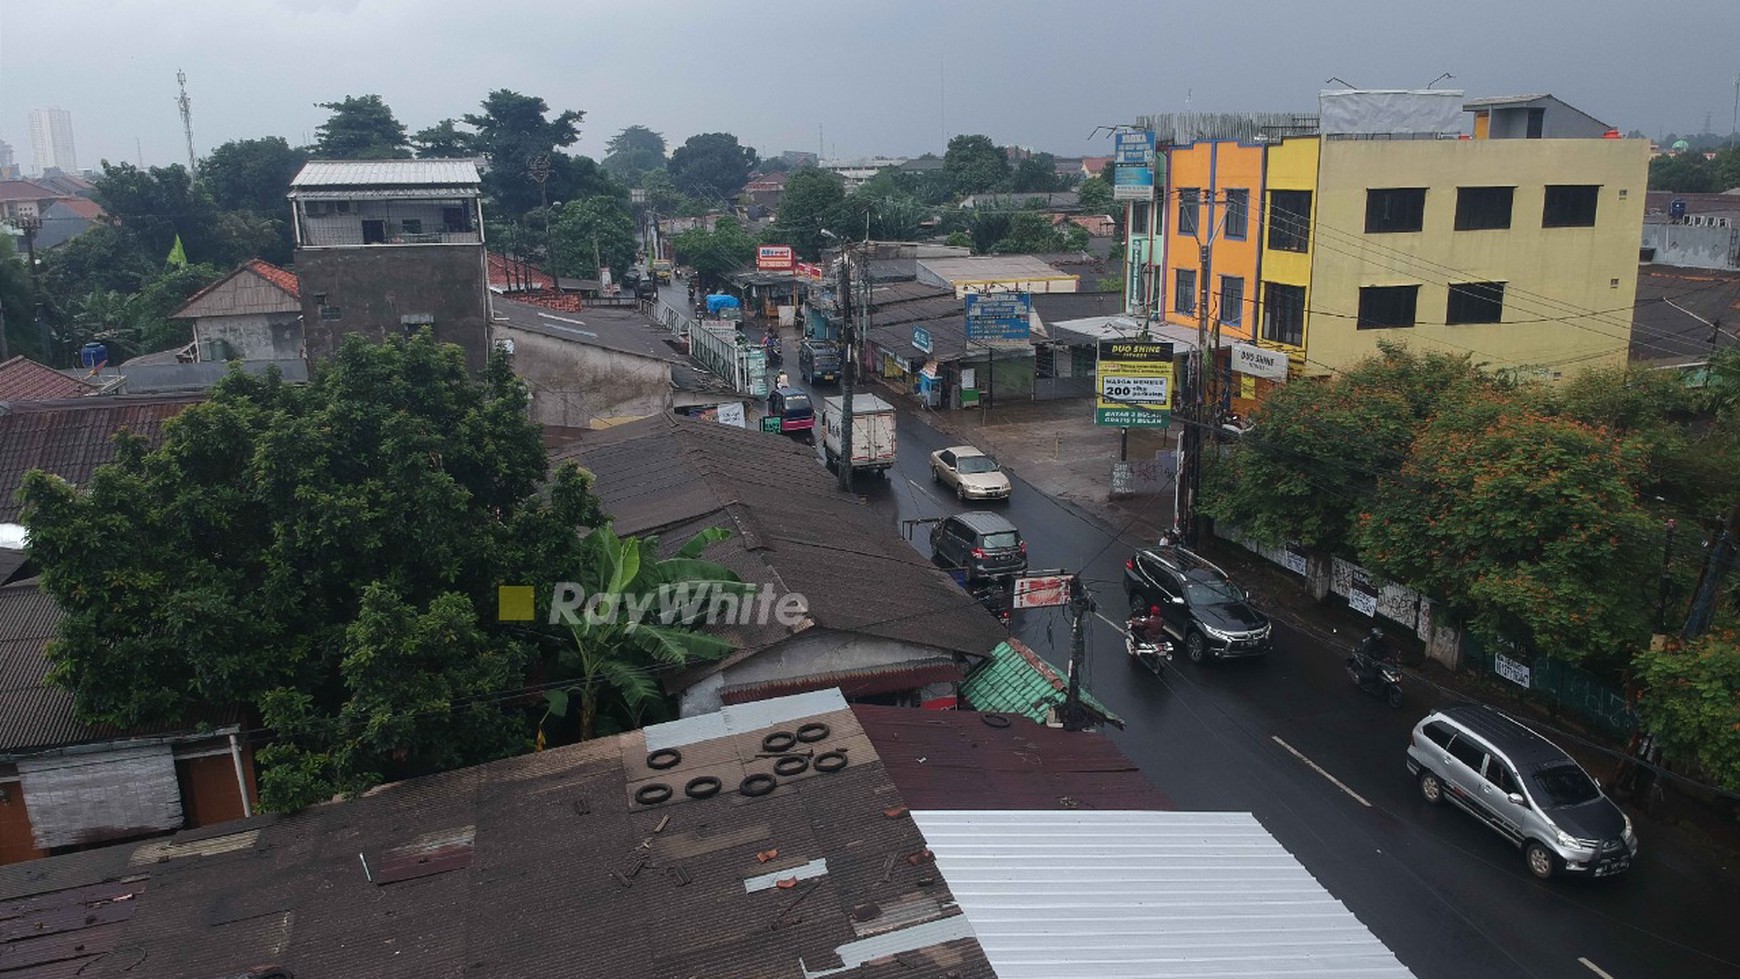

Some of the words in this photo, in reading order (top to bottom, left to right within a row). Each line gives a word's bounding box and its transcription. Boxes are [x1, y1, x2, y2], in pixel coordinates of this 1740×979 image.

[1111, 345, 1132, 353] DUO
[1133, 345, 1161, 353] SHINE
[1106, 386, 1130, 396] 200
